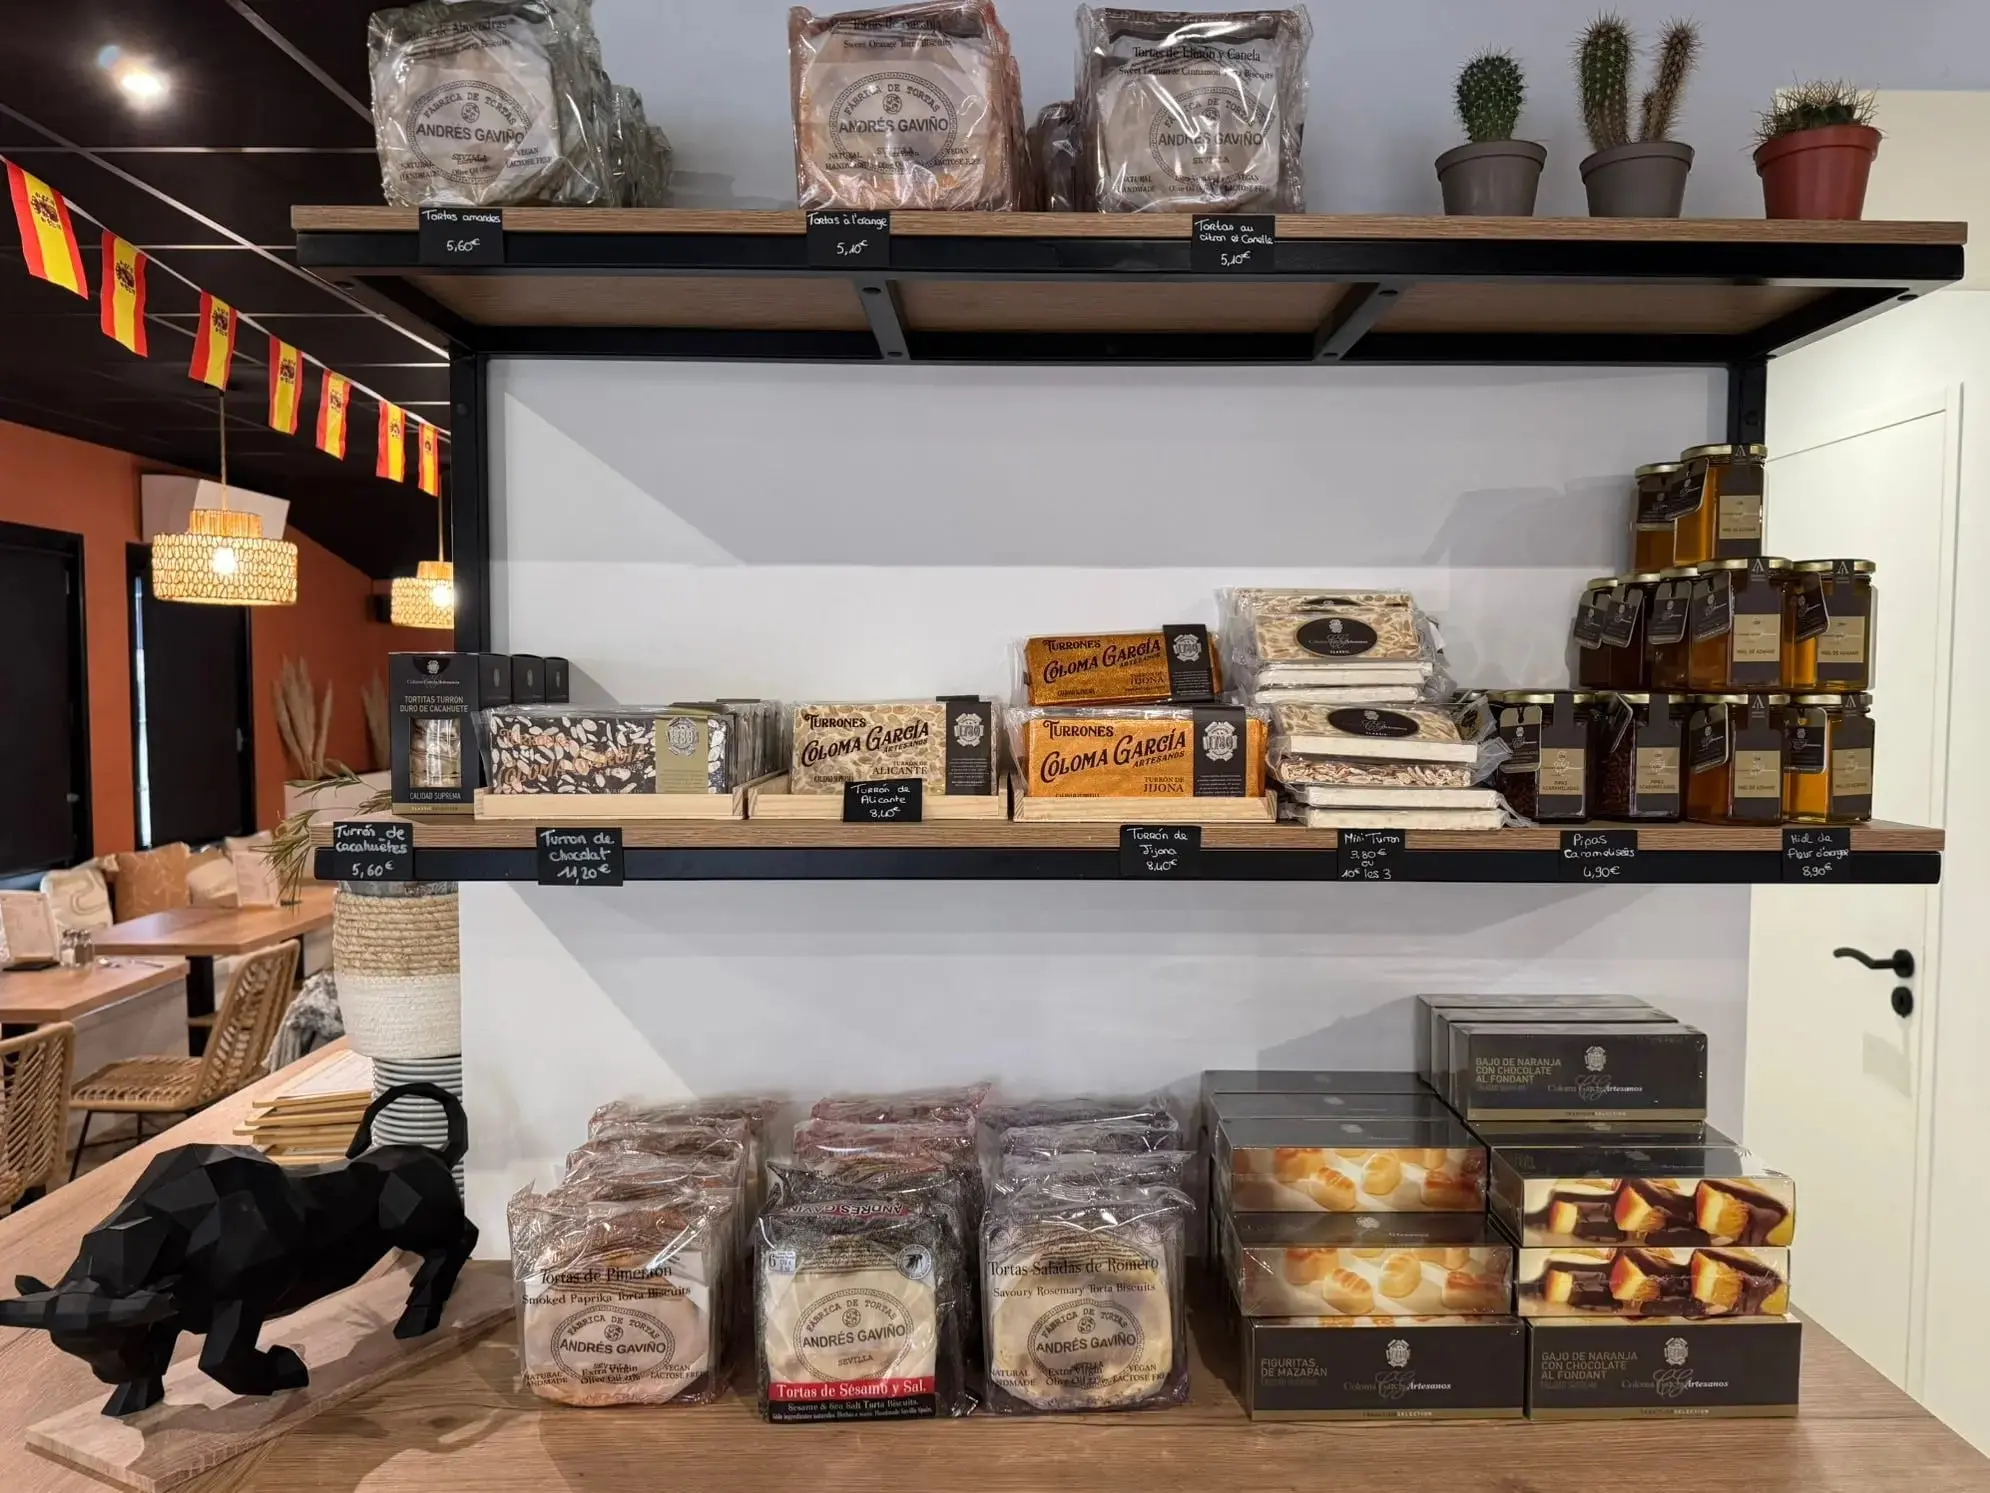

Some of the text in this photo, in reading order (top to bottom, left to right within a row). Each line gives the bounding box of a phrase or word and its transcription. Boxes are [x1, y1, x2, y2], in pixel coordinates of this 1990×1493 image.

[1217, 51, 1225, 61] y
[1227, 47, 1261, 62] Canela
[887, 84, 901, 92] DE
[906, 86, 941, 113] TORTAS
[1207, 98, 1219, 107] DE
[467, 92, 480, 101] DE
[484, 96, 518, 125] TORTAS
[898, 115, 949, 133] GAVIÑO
[421, 209, 501, 223] Tortas amandes
[807, 212, 840, 226] Tortas
[843, 213, 850, 225] à
[1194, 218, 1235, 232] Tortas
[446, 238, 480, 252] 5,60€
[836, 240, 869, 256] 5,10€
[1220, 251, 1251, 267] 5,10€
[429, 705, 469, 713] CACAHUETE
[1133, 751, 1185, 769] ARTESANOS
[872, 766, 928, 775] ALICANTE
[897, 785, 911, 793] de
[1143, 783, 1184, 793] JIJONA
[861, 794, 907, 804] Alicante
[334, 824, 406, 840] Turrón de
[540, 829, 615, 847] Turron de
[1126, 827, 1188, 840] Turrón de
[1344, 832, 1364, 845] Mini
[1817, 832, 1833, 842] de
[1573, 833, 1608, 849] Pipas
[1138, 844, 1178, 858] Jijona
[352, 860, 395, 879] 5,60€
[557, 863, 611, 885] 11,20€
[1364, 868, 1380, 879] les
[1382, 868, 1392, 880] 3
[1583, 865, 1621, 879] 4,90€
[1802, 862, 1833, 878] 8,90€
[1502, 1057, 1516, 1067] DE
[1517, 1057, 1562, 1067] NARANJA
[1475, 1066, 1552, 1075] CON CHOCOLATE
[1475, 1075, 1535, 1083] AL FONDANT
[768, 1253, 777, 1268] 6
[987, 1257, 1159, 1277] Tortas Saladas de Romero
[993, 1282, 1156, 1298] Savoury Rosemary Torta Biscuits
[522, 1294, 566, 1306] Smoked
[570, 1293, 613, 1306] Paprika
[846, 1299, 859, 1308] DE
[864, 1299, 897, 1321] TORTAS
[1083, 1308, 1095, 1316] DE
[611, 1315, 624, 1325] DE
[802, 1324, 906, 1348] ANDRÉS GAVIÑO
[1036, 1331, 1136, 1354] ANDRÉS GAVIÑO
[559, 1338, 666, 1354] ANDRÉS GAVIÑO
[838, 1354, 874, 1367] SEVILLA
[1260, 1357, 1316, 1368] FIGURITAS
[1571, 1351, 1586, 1361] DE
[1588, 1351, 1638, 1361] NARANJA
[1260, 1367, 1274, 1377] DE
[1541, 1361, 1627, 1370] CON CHOCOLATE
[1541, 1370, 1608, 1380] AL FONDANT
[776, 1380, 926, 1399] Tortas de Sésamo y Sal.
[1405, 1379, 1452, 1391] Artesanos
[1683, 1378, 1729, 1390] Artesanos
